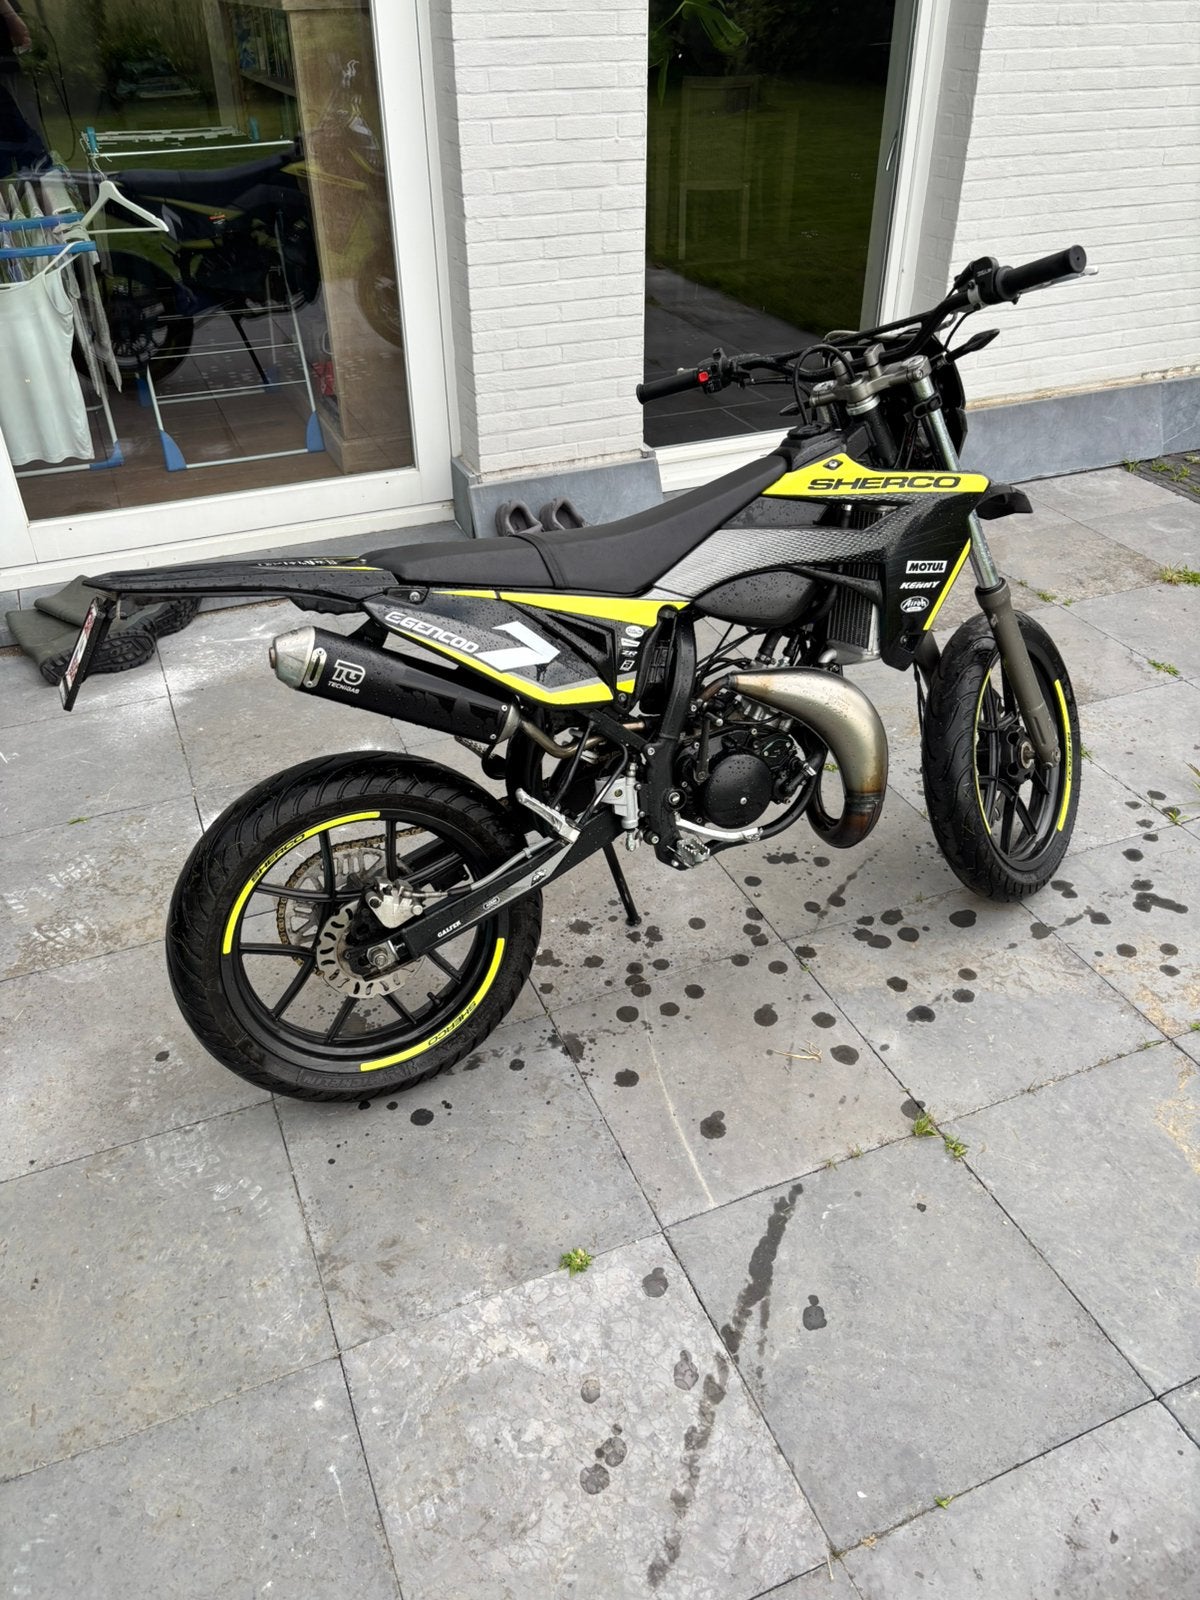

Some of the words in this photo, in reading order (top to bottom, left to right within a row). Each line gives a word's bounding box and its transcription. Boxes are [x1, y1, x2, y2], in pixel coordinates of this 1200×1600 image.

[808, 476, 961, 491] SHERCO
[909, 562, 944, 572] MOTUL
[900, 581, 940, 589] KENNY
[328, 681, 360, 694] TECNIGAS
[251, 834, 305, 883] SHERCO
[437, 920, 462, 938] GALFER
[427, 1000, 477, 1047] SHERCO
